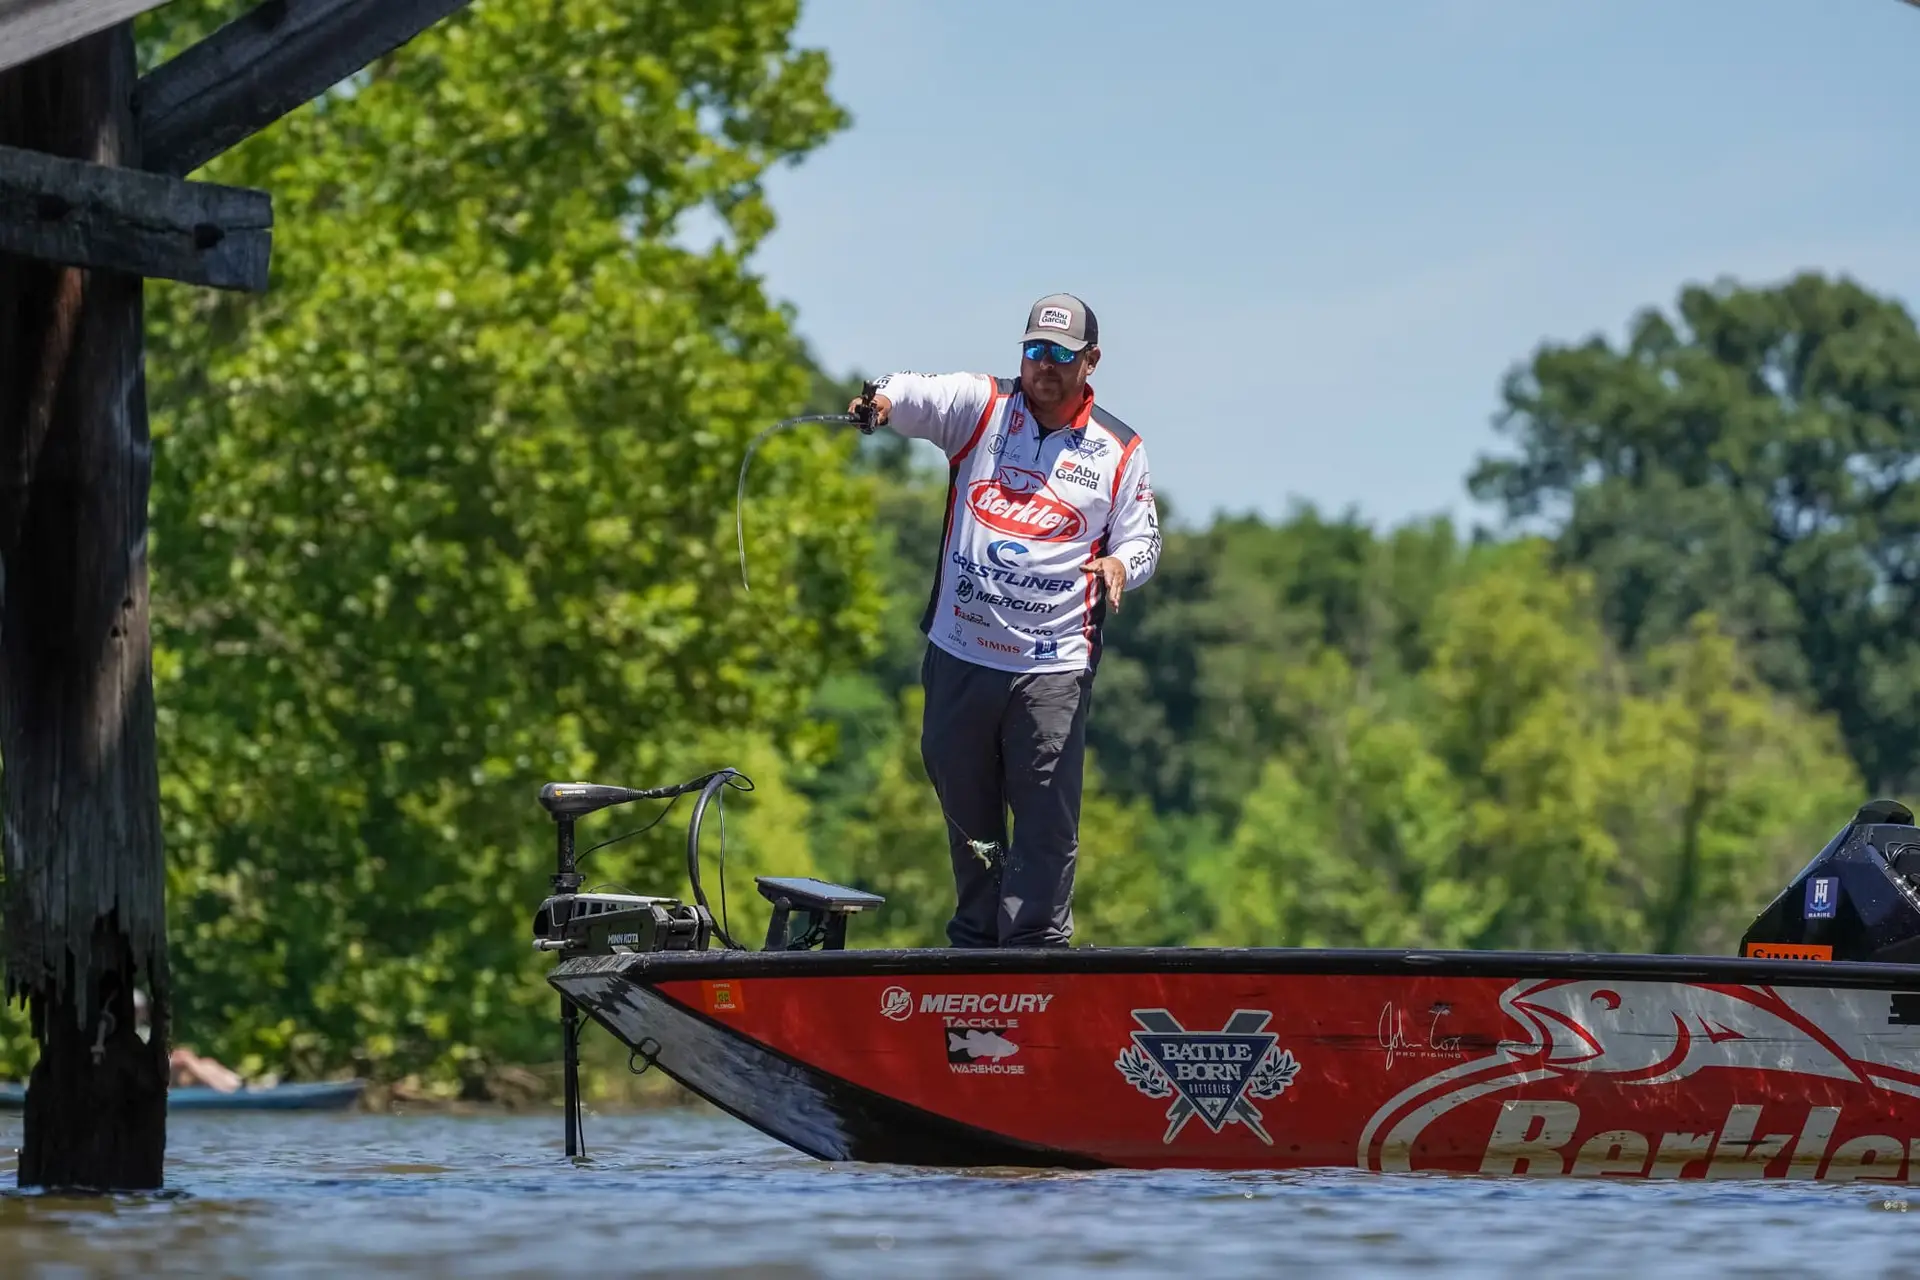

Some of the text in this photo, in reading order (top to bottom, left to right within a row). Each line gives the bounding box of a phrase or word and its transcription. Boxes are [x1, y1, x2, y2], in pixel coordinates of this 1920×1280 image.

[1041, 316, 1067, 325] Garcia
[1052, 311, 1068, 319] Abu
[1055, 468, 1098, 490] Garcia
[1073, 464, 1100, 481] Abu
[975, 487, 1077, 537] Berkley
[952, 552, 1076, 592] CRESTLINER
[976, 591, 1059, 614] MERCURY
[977, 636, 1021, 654] SIMMS
[624, 933, 639, 943] KOTA
[919, 993, 1055, 1013] MERCURY
[942, 1016, 1019, 1028] TACKLE
[1161, 1043, 1252, 1061] BATTLE
[949, 1063, 1025, 1075] WAREHOUSE
[1175, 1063, 1242, 1081] BORN
[1188, 1083, 1232, 1094] BATTERIES
